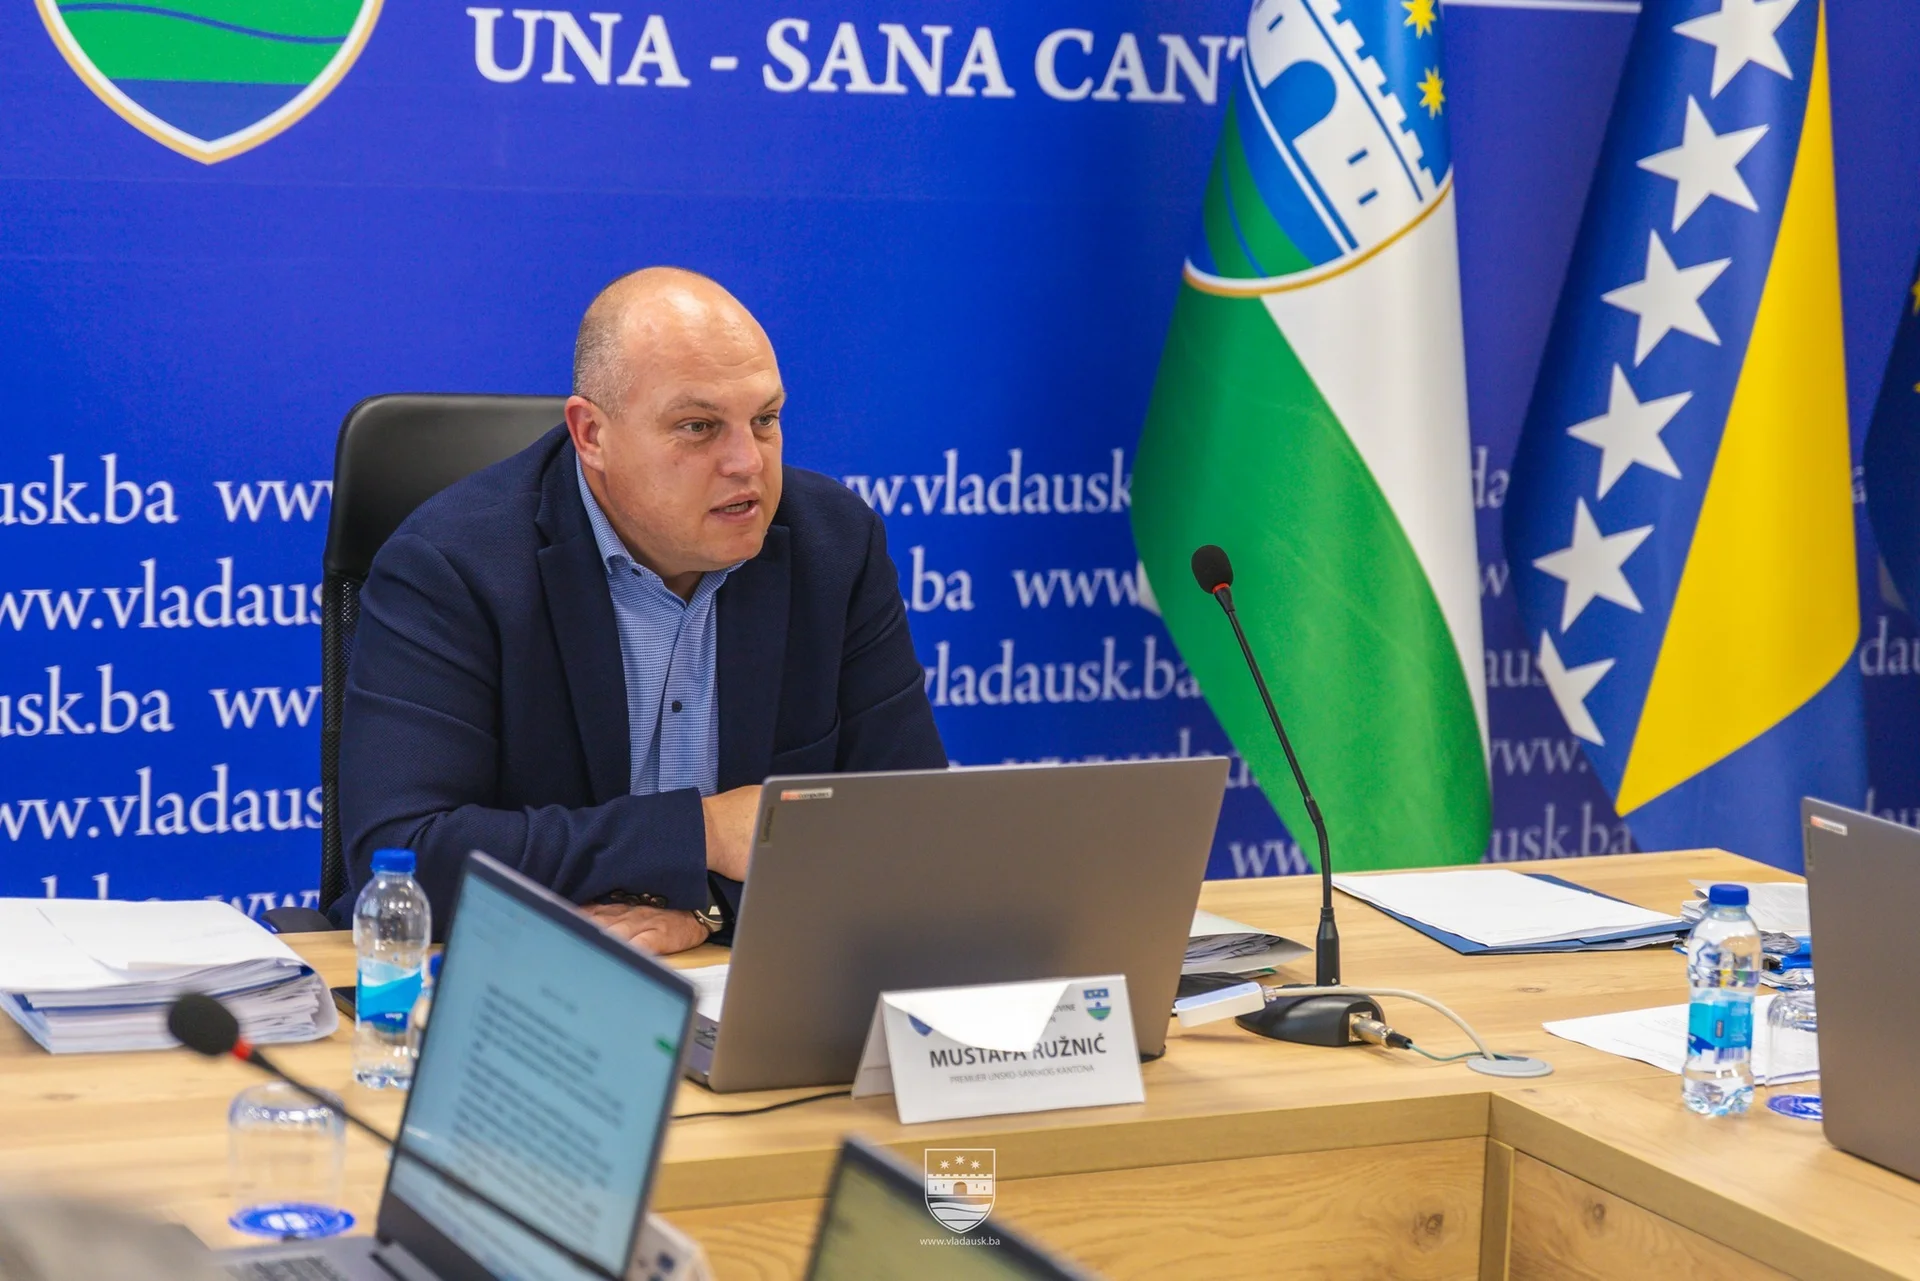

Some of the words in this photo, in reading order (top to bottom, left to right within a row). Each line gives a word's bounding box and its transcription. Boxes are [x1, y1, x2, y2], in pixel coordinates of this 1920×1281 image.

[466, 7, 691, 87] UNA
[710, 56, 739, 70] -
[762, 18, 1015, 97] SANA
[213, 480, 333, 523] ww
[929, 1047, 1027, 1068] MUSTAFA
[1033, 1033, 1107, 1060] RUŽNIĆ
